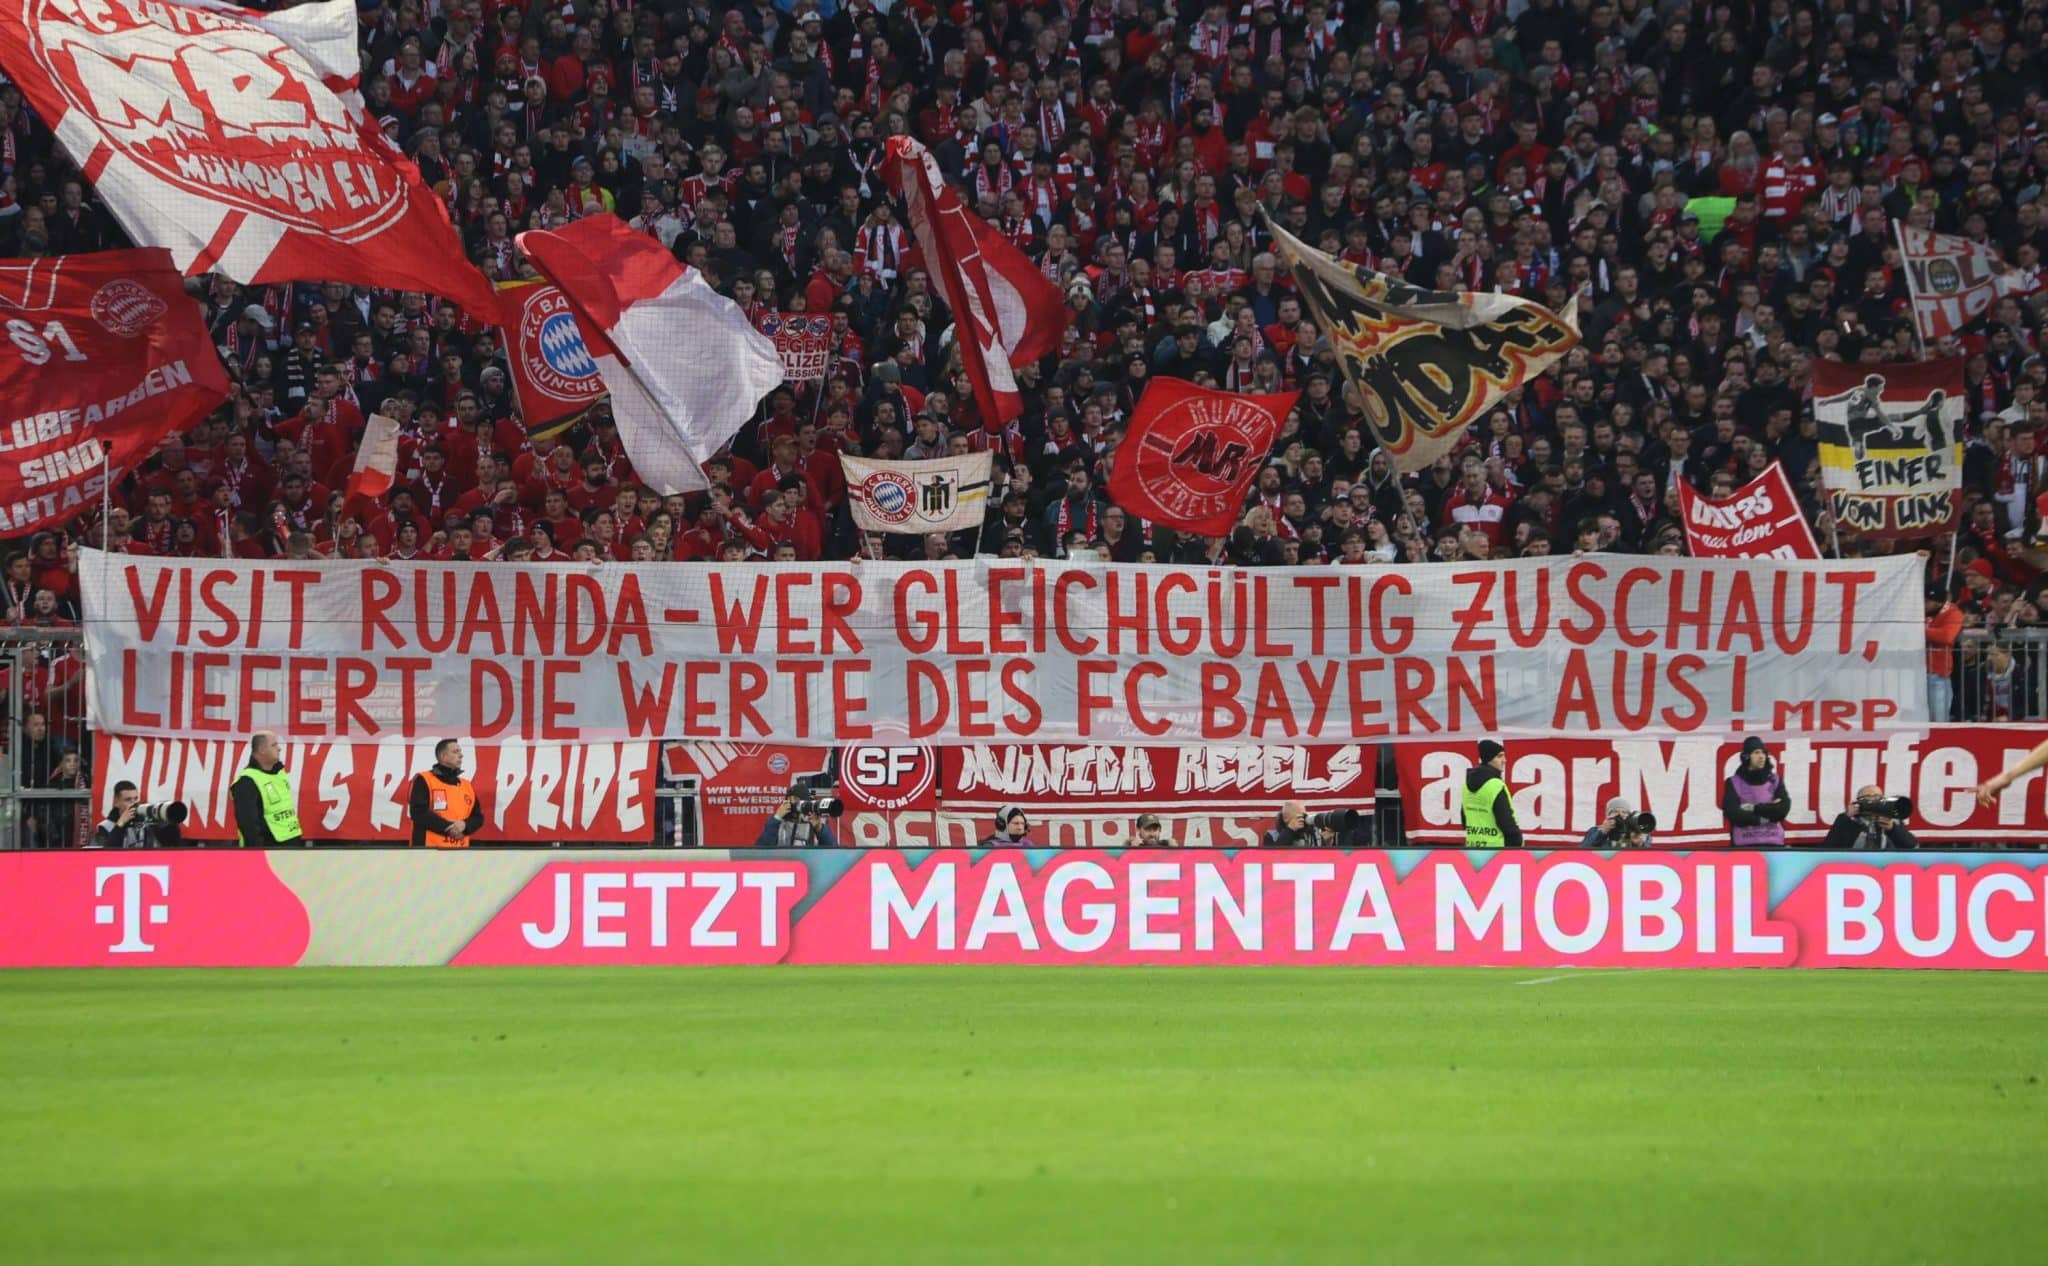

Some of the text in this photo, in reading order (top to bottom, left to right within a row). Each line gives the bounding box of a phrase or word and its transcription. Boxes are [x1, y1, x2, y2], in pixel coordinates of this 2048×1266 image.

[776, 338, 827, 353] EGEN
[19, 437, 104, 490] SIND
[1856, 455, 1947, 490] EINER
[1832, 490, 1953, 532] VON UNS
[1732, 521, 1775, 547] dem
[125, 565, 321, 650] VISIT
[894, 567, 1414, 659] GLEICHGÜLTIG
[1452, 562, 1880, 663] ZUSCHAUT,
[123, 649, 433, 740] LIEFERT
[470, 659, 580, 740] DIE
[618, 660, 873, 740] WERTE
[908, 659, 1043, 741] DES
[1078, 659, 1171, 738] FC
[1201, 656, 1498, 739] BAYERN
[1553, 650, 1747, 732] AUS!
[1773, 699, 1898, 732] MRP
[494, 735, 650, 833] PRIDE
[856, 746, 920, 786] SF
[957, 742, 1363, 797] MUNICH REBELS
[706, 785, 788, 795] WIR WOLLEN
[722, 805, 774, 815] TRIKOTS
[867, 796, 909, 810] FCBM
[1466, 825, 1499, 837] EWARD
[521, 861, 2048, 960] JETZT MAGENTA MOBIL BUC
